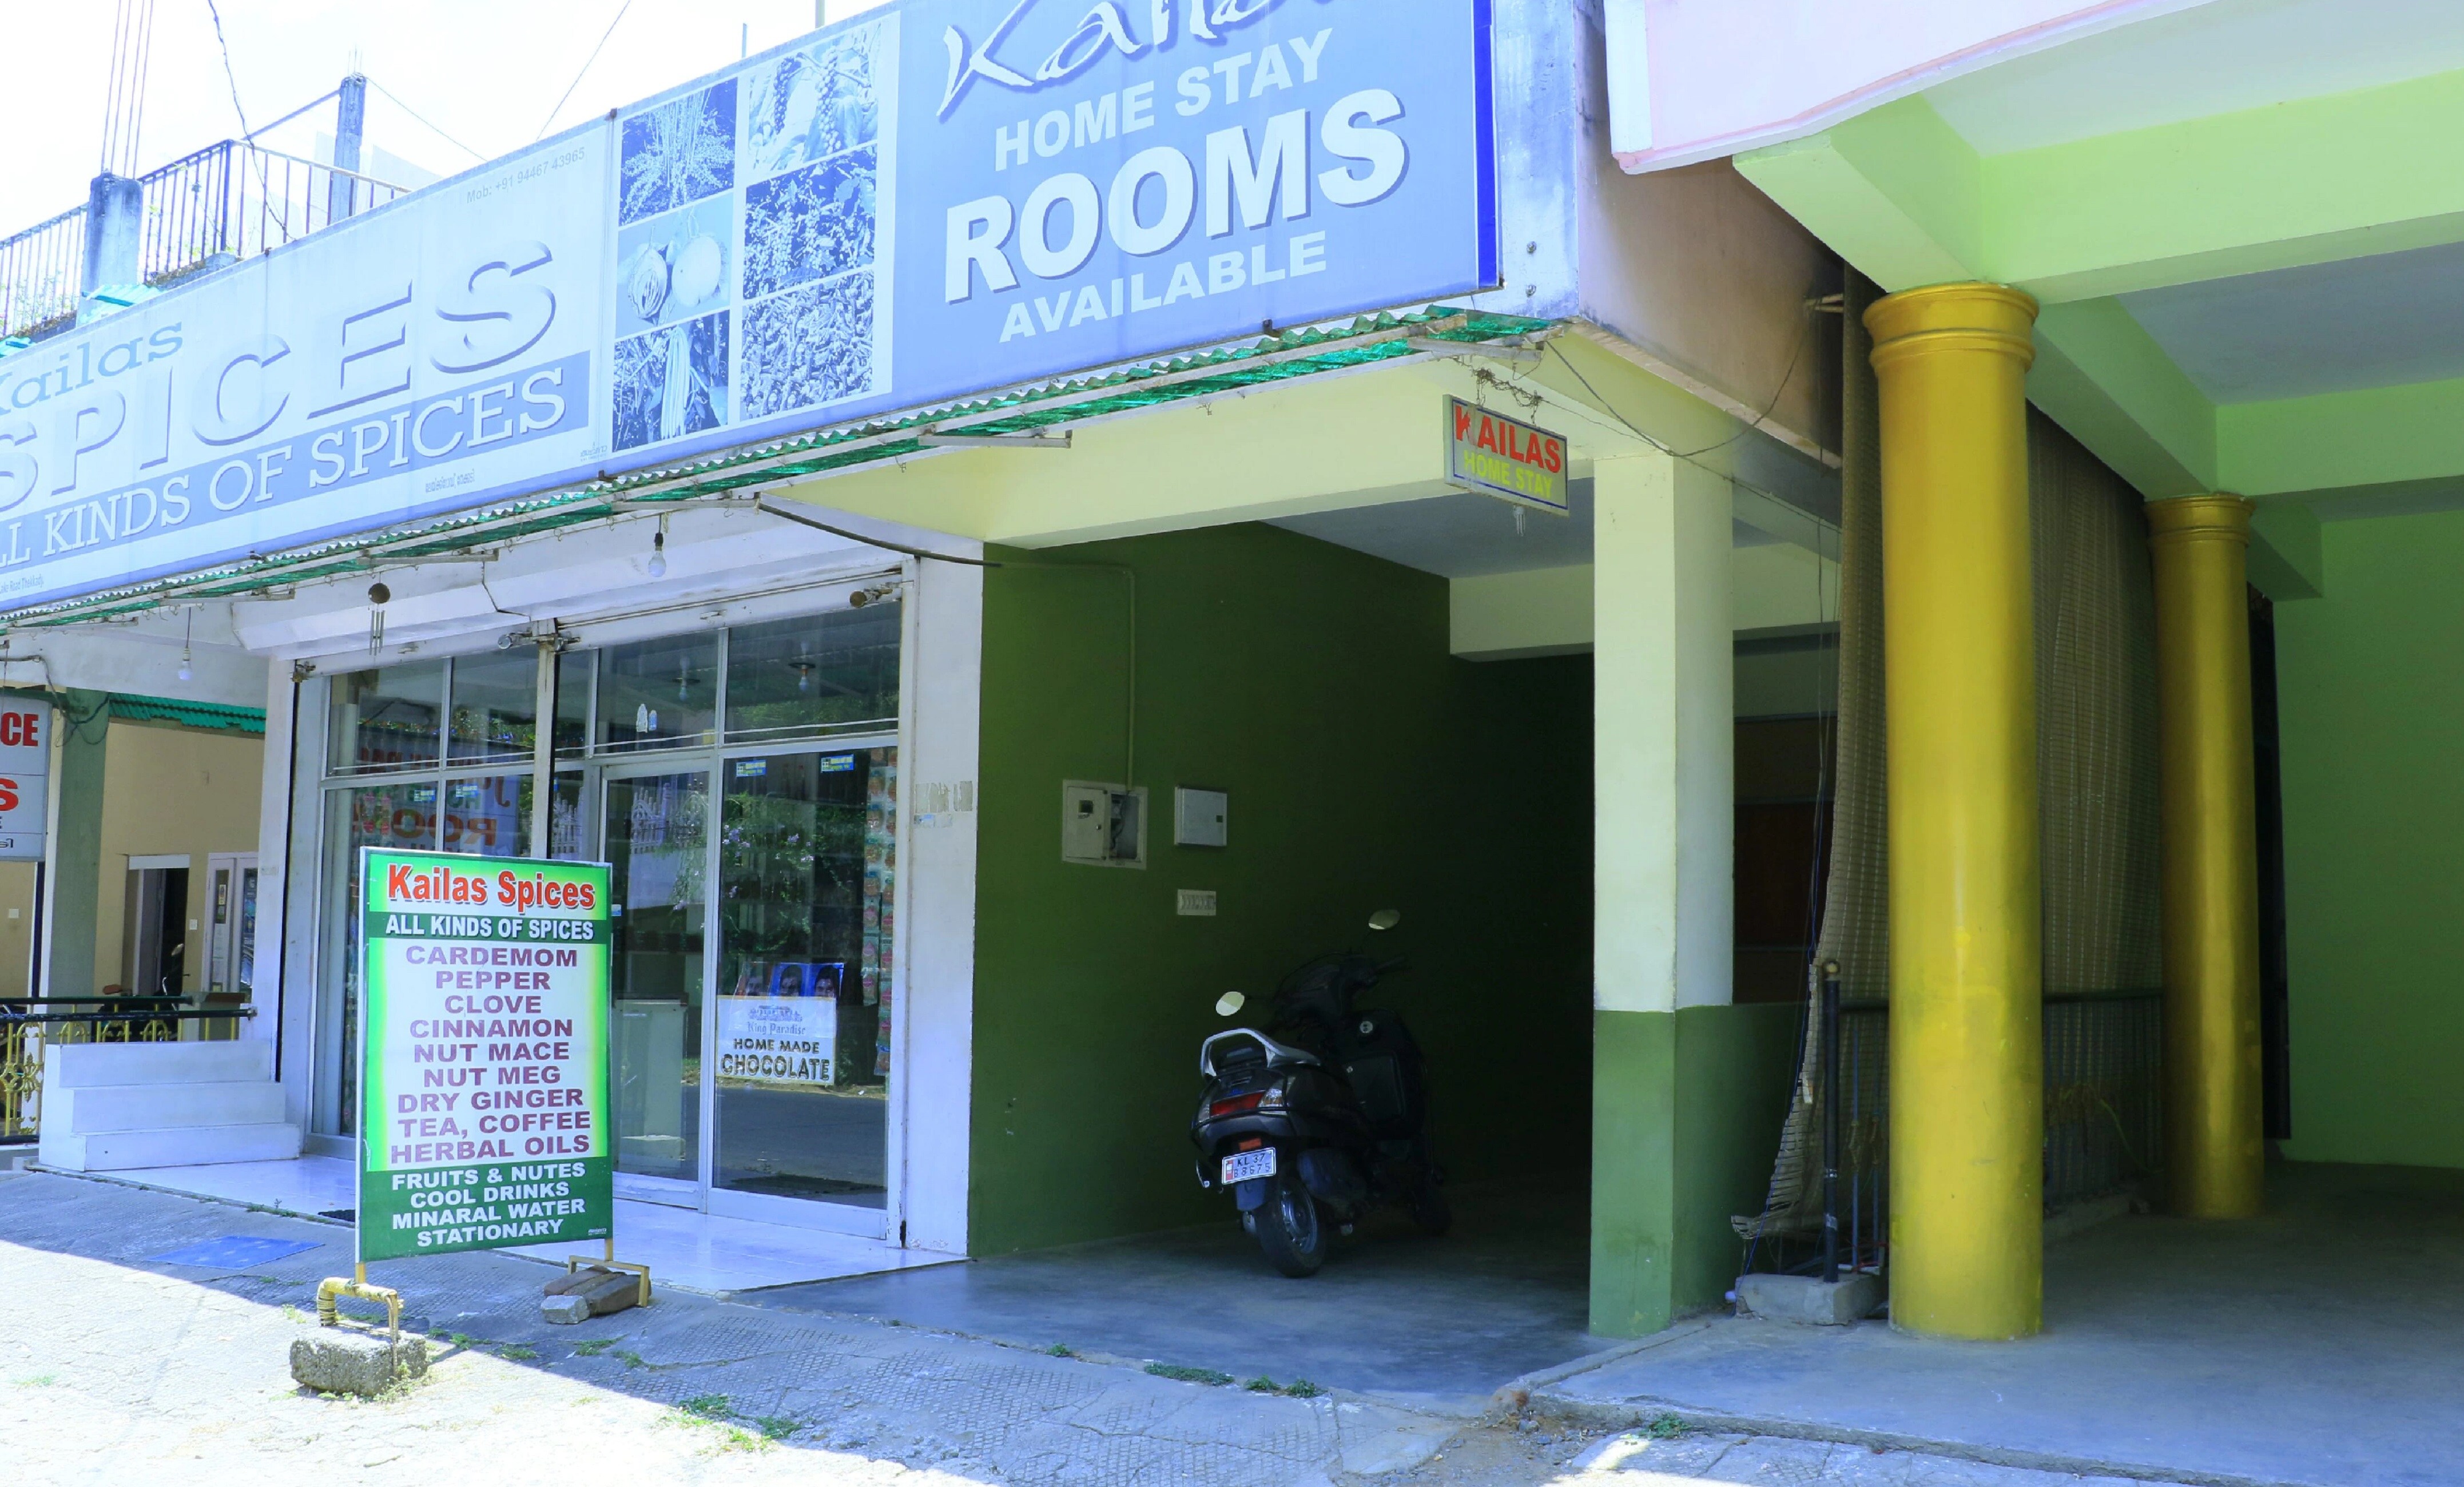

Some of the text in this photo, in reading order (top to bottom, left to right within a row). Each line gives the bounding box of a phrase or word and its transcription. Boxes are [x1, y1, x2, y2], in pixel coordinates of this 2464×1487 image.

[994, 28, 1333, 173] HOME STAY
[467, 146, 585, 203] Mob: +91 94467 43965
[944, 89, 1408, 304] ROOMS
[999, 230, 1327, 343] AVAILABLE
[1454, 405, 1561, 474] KAILAS
[43, 474, 192, 556] KINDS
[209, 438, 294, 512] OF
[308, 367, 566, 488] SPICES
[1464, 450, 1552, 499] HOME STAY
[387, 863, 595, 914] Kailas Spices
[386, 914, 594, 940] ALL KINDS OF SPICES
[406, 945, 577, 967] CARDEMOM
[436, 971, 551, 990] PEPPER
[444, 995, 542, 1014] CLOVE
[410, 1019, 573, 1038] CINNAMON
[770, 1023, 805, 1035] Paradise
[414, 1041, 570, 1063] NUT MACE
[734, 1038, 820, 1054] HOME MADE
[424, 1065, 561, 1087] NUT MEG
[720, 1053, 830, 1080] CHOCOLATE
[398, 1088, 583, 1114] DRY GINGER
[398, 1111, 591, 1139] TEA, COFFEE
[391, 1134, 590, 1164] HERBAL OILS
[1237, 1152, 1266, 1167] KL 37
[392, 1162, 586, 1190] FRUITS & NUTES
[410, 1181, 569, 1208] COOL DRINKS
[392, 1198, 586, 1230] MINARAL WATER
[417, 1218, 564, 1247] STATIONARY
